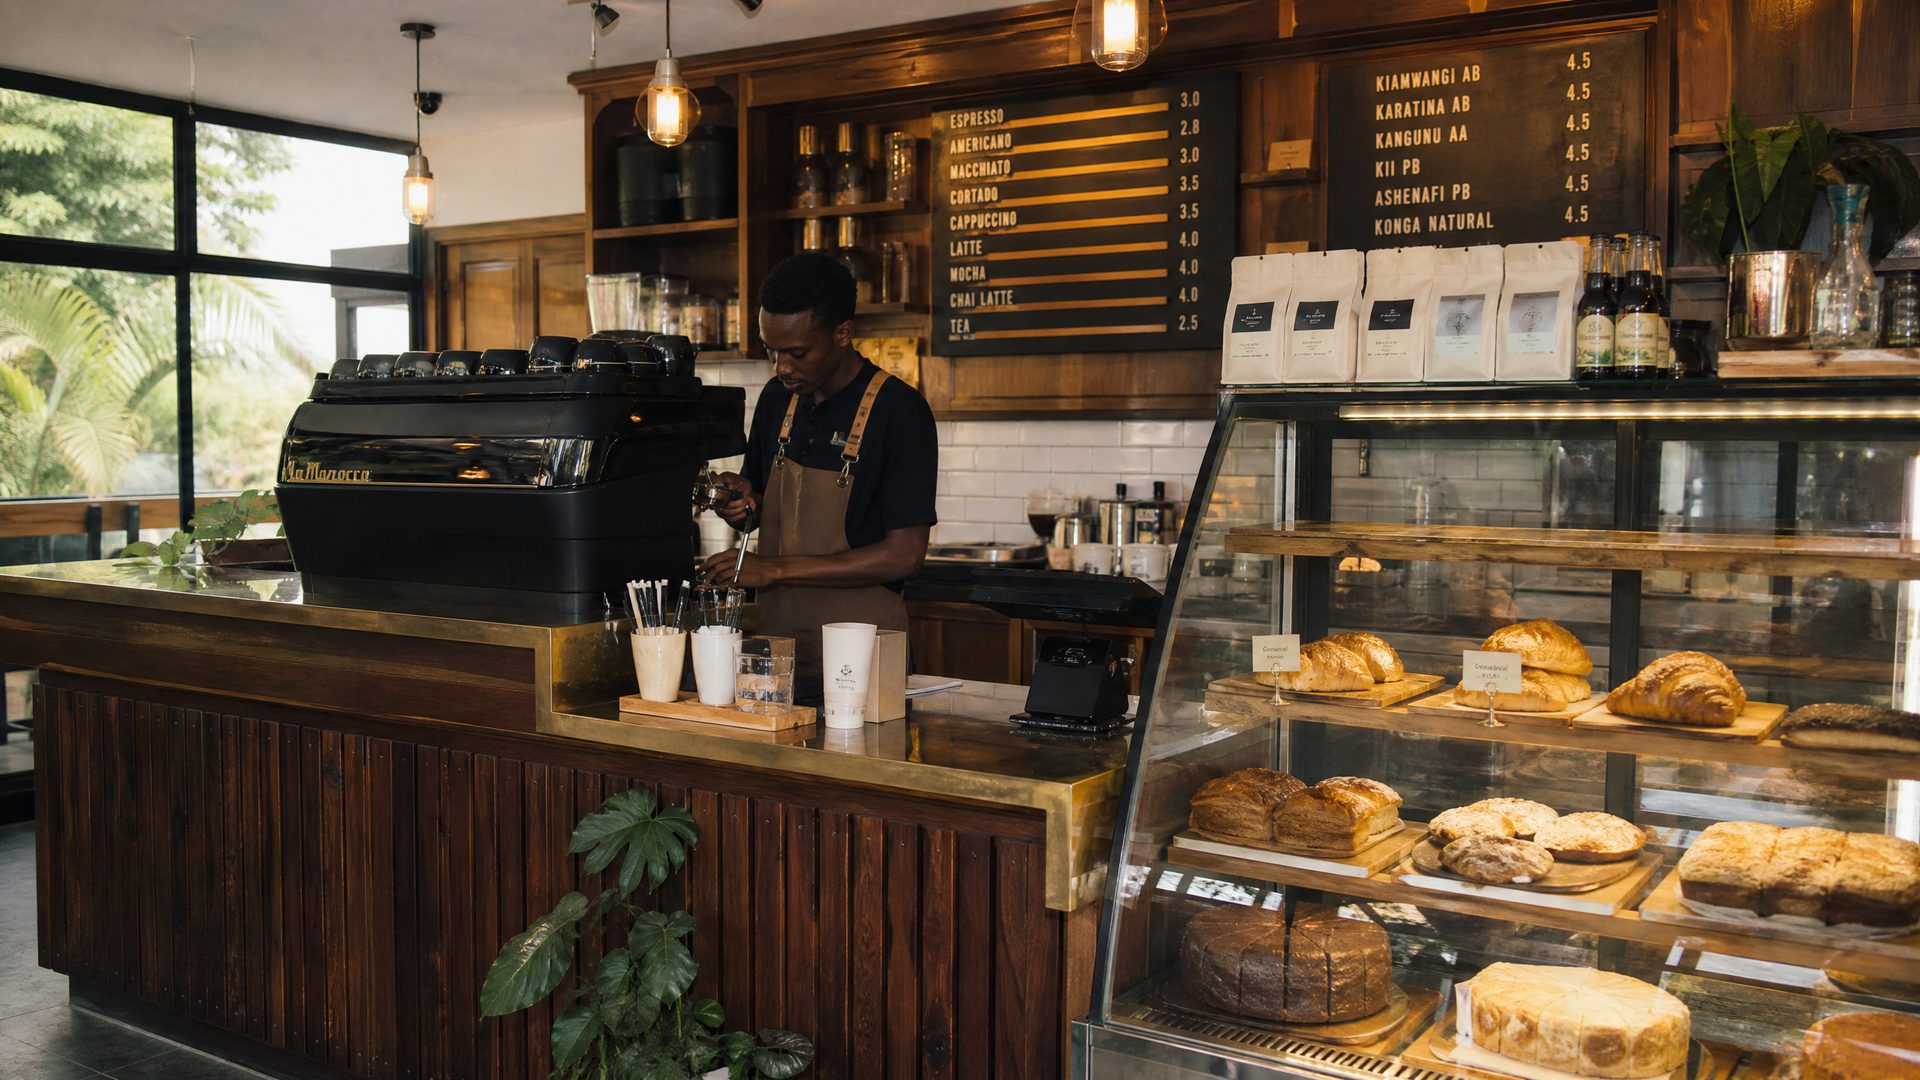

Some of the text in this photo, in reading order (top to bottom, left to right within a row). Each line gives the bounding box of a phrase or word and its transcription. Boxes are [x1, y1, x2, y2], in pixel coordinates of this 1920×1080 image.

[1375, 51, 1591, 92] KIAMWANGI AB 4.5
[950, 91, 1200, 129] ESPRESSO 3.0
[1375, 82, 1590, 121] KARATINA AB 4.5
[950, 119, 1200, 154] AMERICANO 2.8
[1375, 112, 1590, 149] KANGUNU AA 4.5
[950, 147, 1200, 180] MACCHIATO 3.0
[1375, 143, 1589, 178] KII PB 4.5
[950, 175, 1199, 206] CORTADO 3.5
[1374, 174, 1589, 207] ASHENAFI PB 4.5
[950, 203, 1199, 231] CAPPUCCINO 3.5
[1374, 204, 1588, 236] KONGA NATURAL 4.5
[950, 231, 1199, 257] LATTE 4.0
[950, 259, 1198, 282] MOCHA 4.0
[950, 287, 1198, 308] CHAI LATTE 4.0
[950, 315, 1198, 333] TEA 2.5
